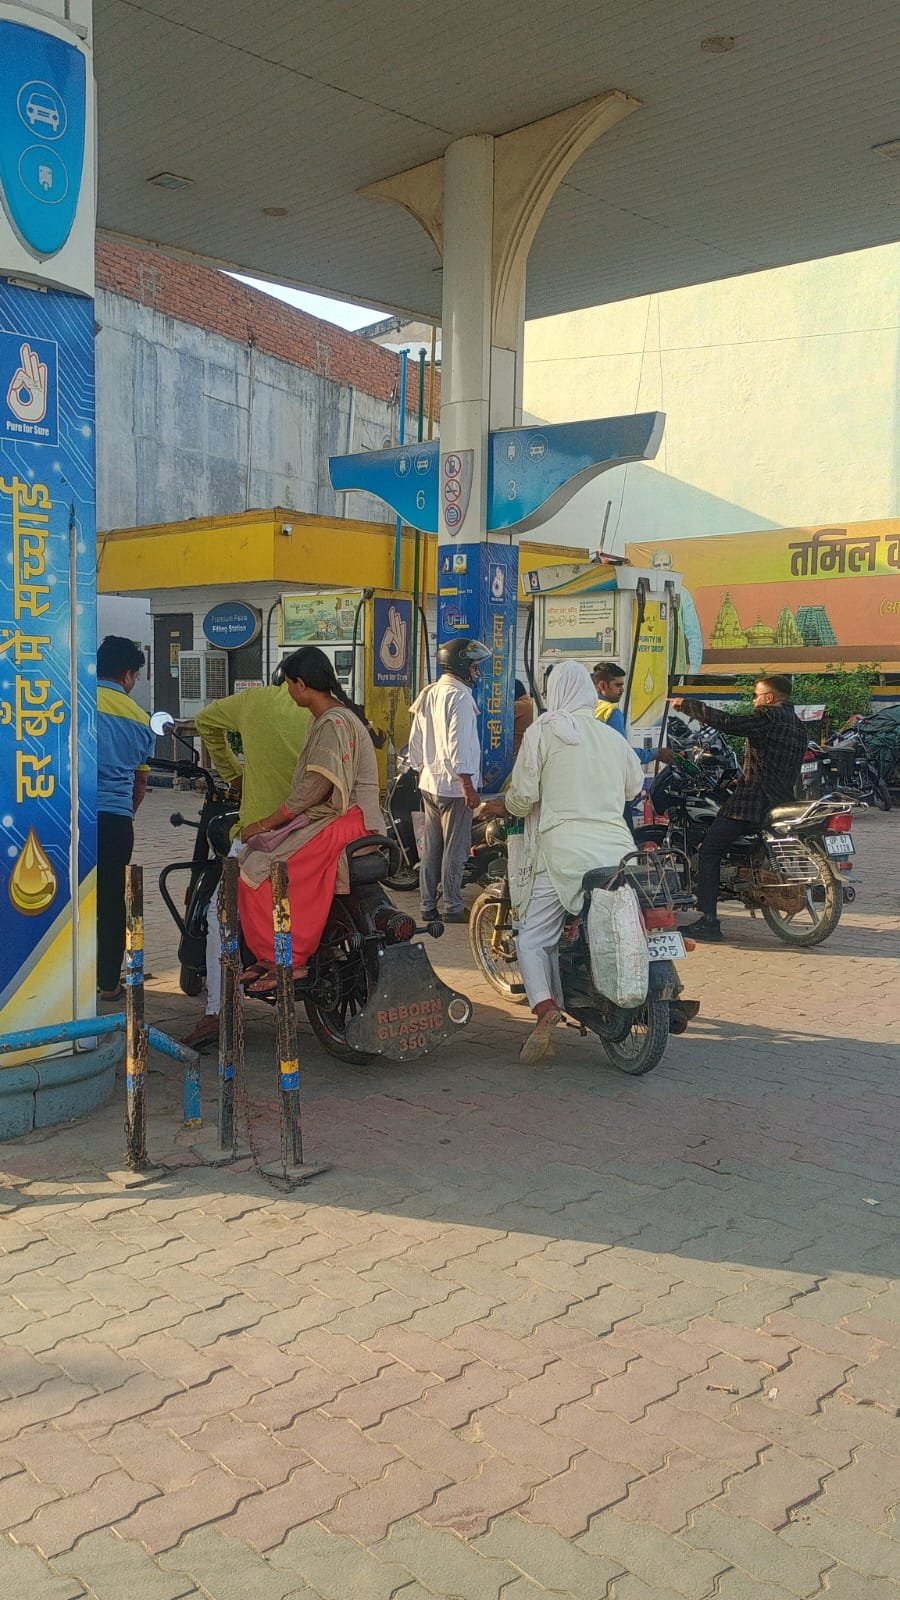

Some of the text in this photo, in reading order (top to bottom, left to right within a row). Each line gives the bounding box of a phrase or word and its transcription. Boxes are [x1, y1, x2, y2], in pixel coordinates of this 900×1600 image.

[6, 421, 49, 437] Pure for Sure
[416, 489, 425, 510] 6
[507, 480, 517, 501] 3
[0, 476, 53, 620] सच्चाई
[790, 529, 879, 576] तमिल
[212, 624, 246, 635] Filling Station
[0, 629, 51, 662] में
[492, 654, 504, 676] का
[487, 720, 502, 750] सही
[16, 750, 55, 803] हर
[378, 999, 441, 1024] REBORN
[378, 1016, 441, 1040] CLASSIC
[399, 1035, 425, 1052] 350
